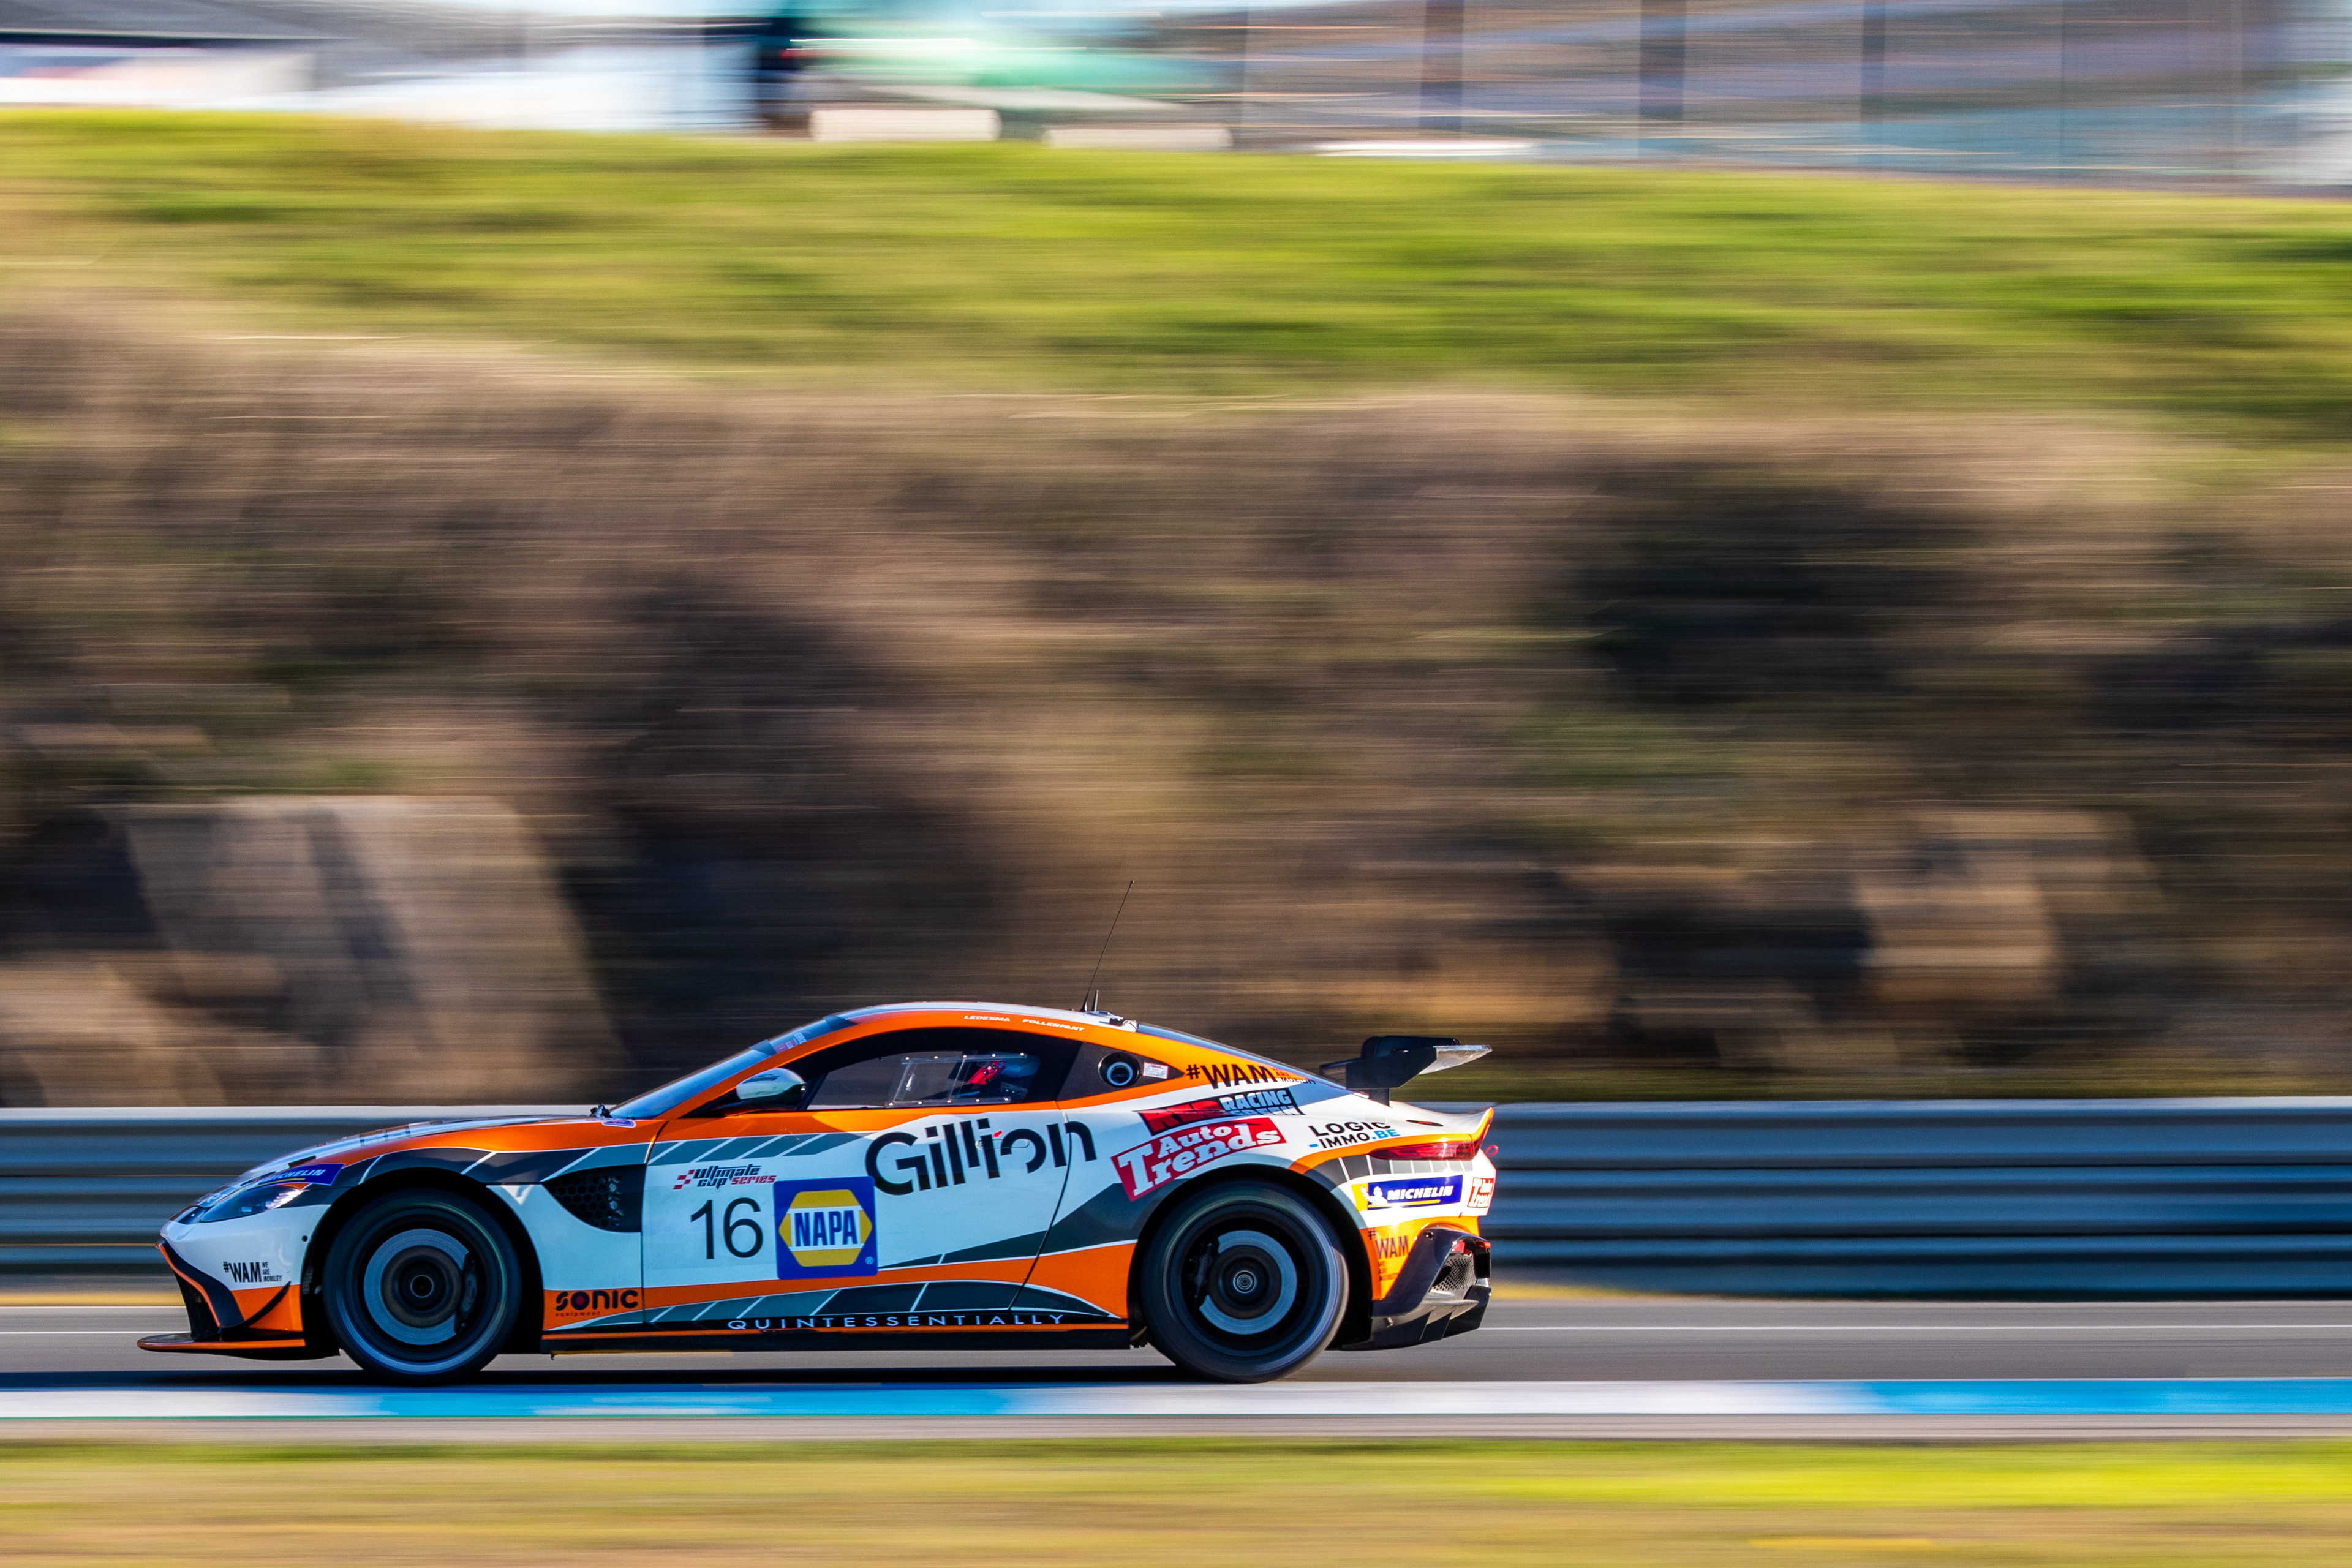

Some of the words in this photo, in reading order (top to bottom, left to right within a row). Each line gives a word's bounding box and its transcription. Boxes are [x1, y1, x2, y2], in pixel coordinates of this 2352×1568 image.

[1022, 1019, 1085, 1031] FOLLENFANT
[1186, 1064, 1278, 1089] #WAM
[1219, 1090, 1291, 1110] RACING
[1308, 1122, 1391, 1137] LOGIC
[1158, 1126, 1232, 1158] Auto
[1120, 1123, 1281, 1196] Trends
[1387, 1185, 1454, 1200] MICHELIN
[690, 1197, 763, 1260] 16
[794, 1210, 858, 1247] NAPA
[223, 1262, 262, 1283] #WAM
[728, 1314, 1063, 1329] QUINTESSENTIALLY
